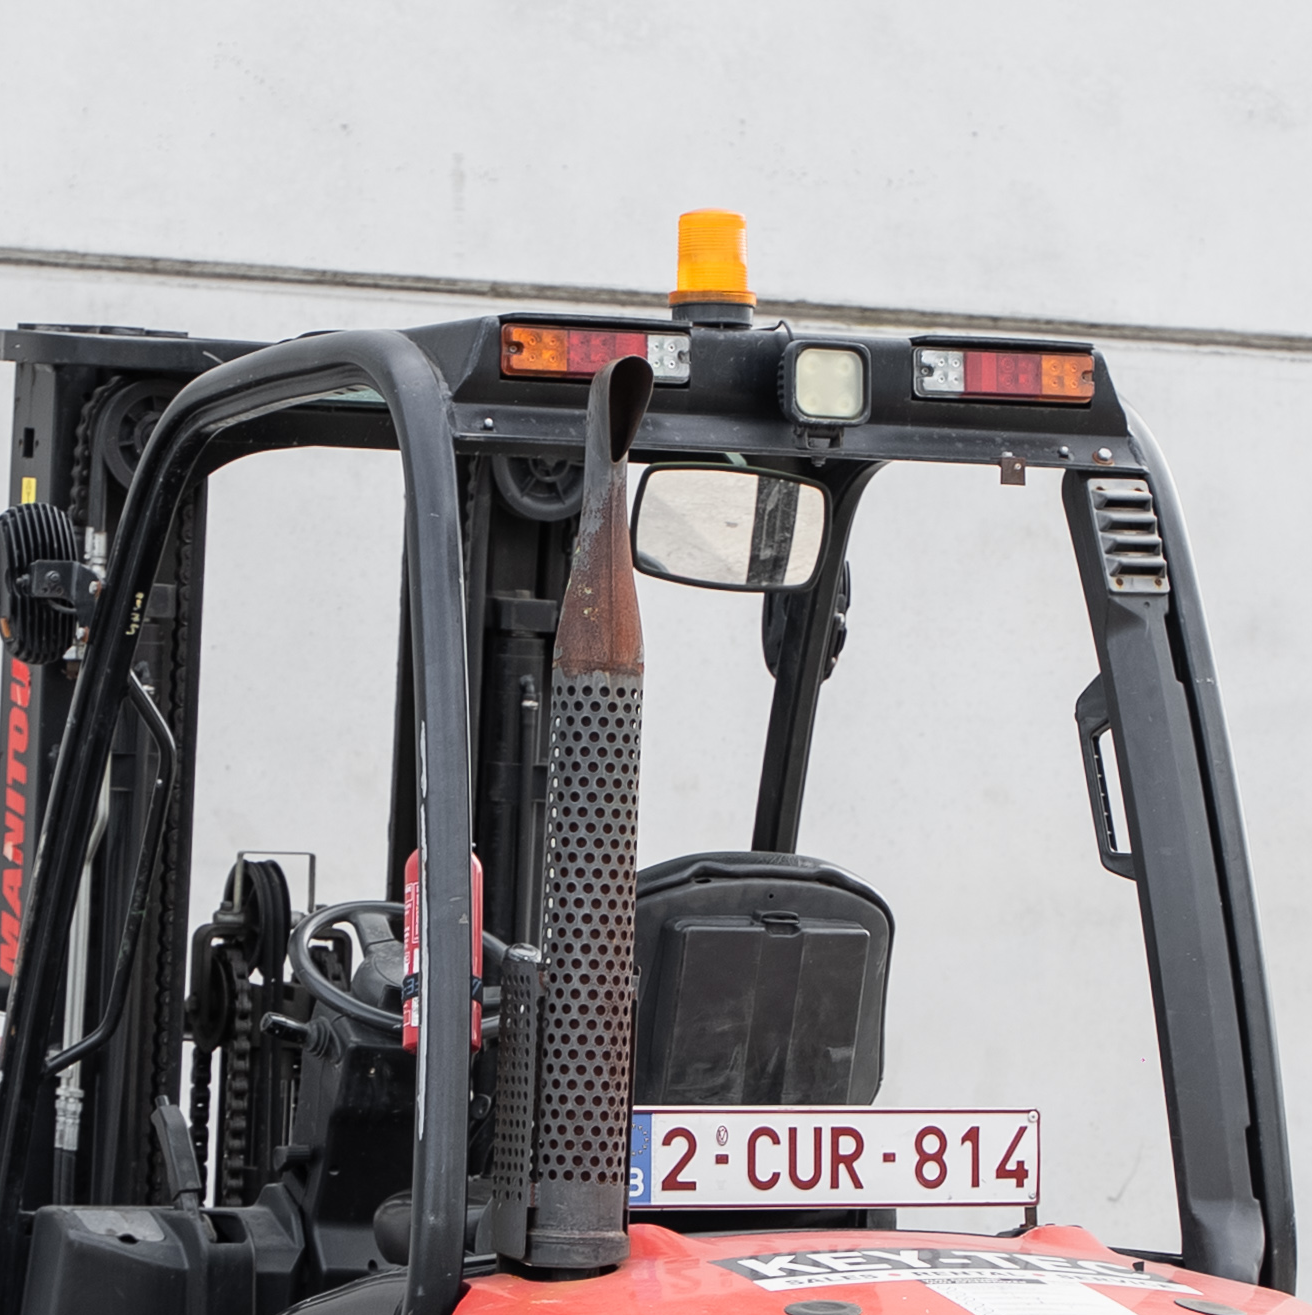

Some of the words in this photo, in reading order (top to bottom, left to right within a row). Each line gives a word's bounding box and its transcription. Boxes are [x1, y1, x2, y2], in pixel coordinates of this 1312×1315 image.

[0, 657, 31, 978] MANITOU
[661, 1125, 1029, 1191] 2-CUR-814
[737, 1249, 1151, 1280] KEY-TEC
[785, 1272, 879, 1287] SALES
[912, 1270, 1026, 1278] RENTAL
